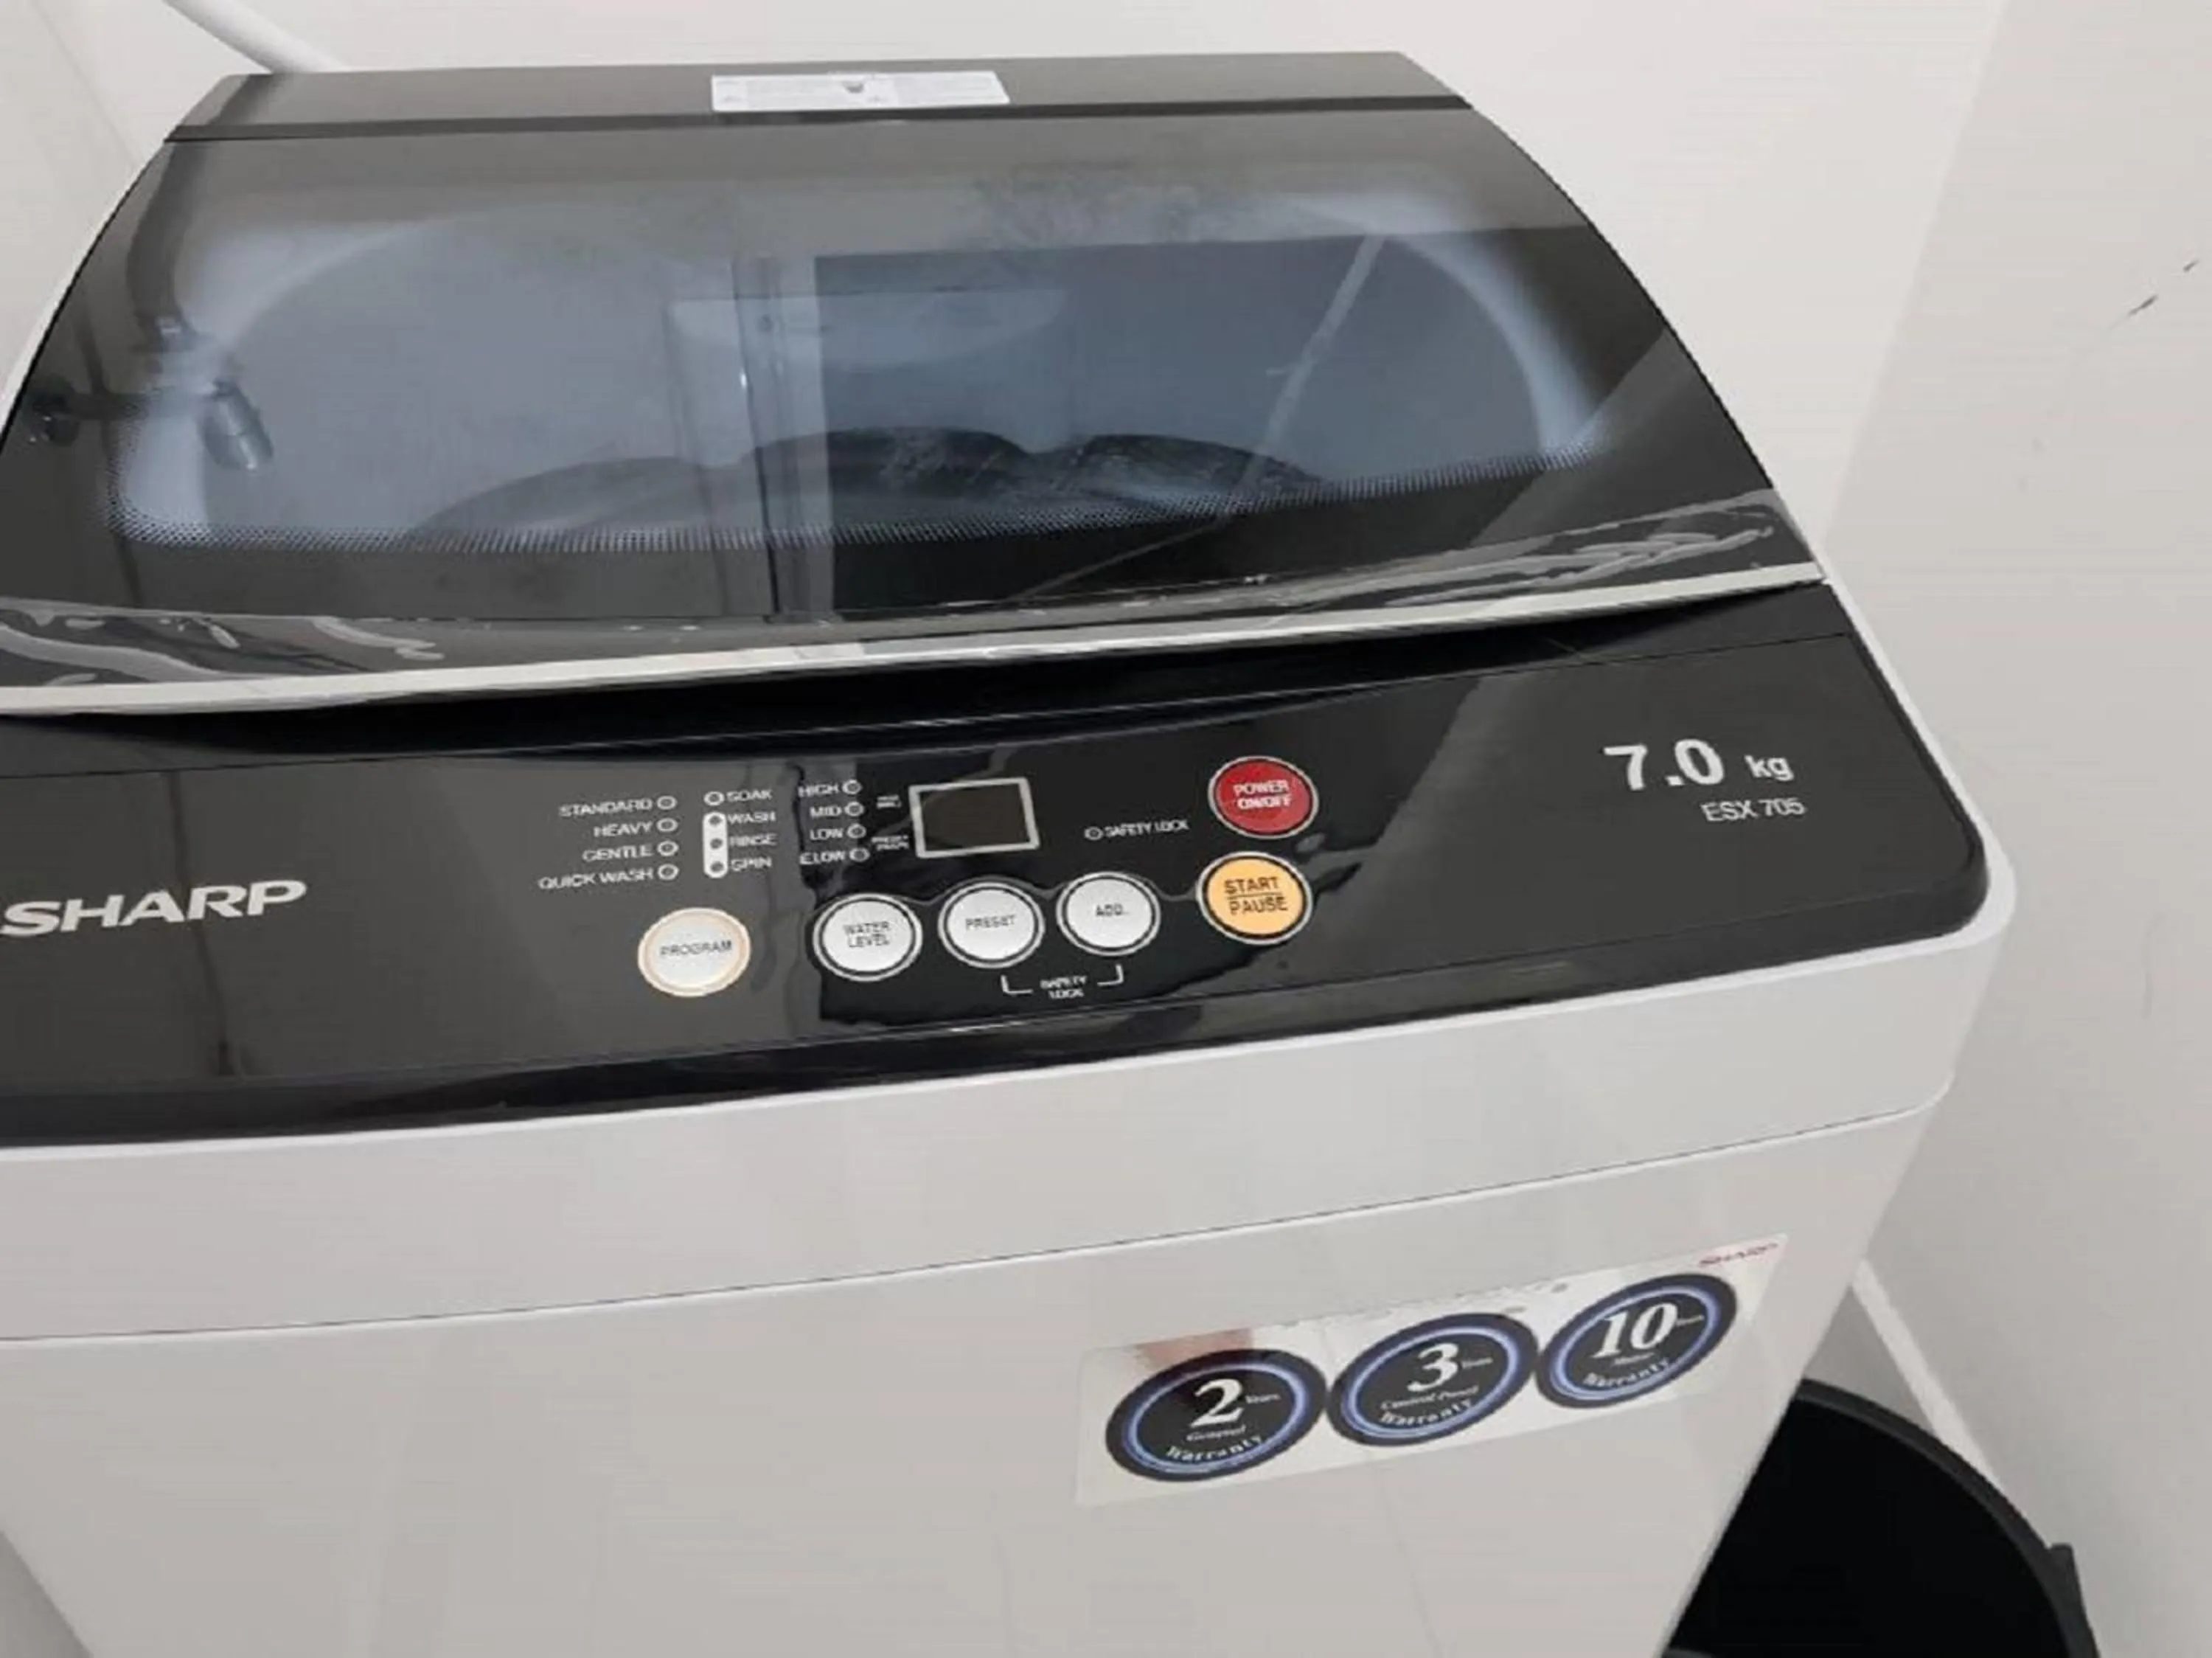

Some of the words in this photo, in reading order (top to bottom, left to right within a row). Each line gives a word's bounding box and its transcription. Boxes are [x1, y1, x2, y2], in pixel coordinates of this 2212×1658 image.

[1602, 738, 1725, 791] 7.0
[1744, 755, 1795, 782] kg
[726, 788, 773, 802] SOAK
[798, 784, 839, 798] HIGH
[1233, 779, 1289, 797] POWER
[559, 798, 653, 816] STANDARD
[810, 805, 841, 817] MID
[1700, 799, 1759, 822] ESX
[1759, 797, 1807, 816] 705
[727, 811, 776, 825] WASH
[594, 821, 653, 837] HEAVY
[810, 828, 844, 841] LOW
[1105, 822, 1152, 838] SAFETY
[1153, 819, 1189, 833] LOCK
[728, 833, 777, 847] RINSE
[582, 845, 653, 862] GENTLE
[729, 857, 773, 872] SPIN
[538, 873, 596, 890] QUICK
[599, 868, 654, 885] WASH
[1224, 876, 1280, 895] START
[0, 880, 307, 937] SHARP
[1229, 897, 1289, 915] PAUSE
[843, 921, 889, 936] WATER
[966, 914, 1016, 931] PRESET
[660, 940, 732, 957] PROGRAM
[847, 933, 890, 948] LEVEL
[1590, 1303, 1678, 1359] 10
[1407, 1342, 1459, 1392] 3
[1188, 1378, 1244, 1428] 2
[1379, 1398, 1472, 1426] Warranty
[1165, 1435, 1262, 1462] Warranty
